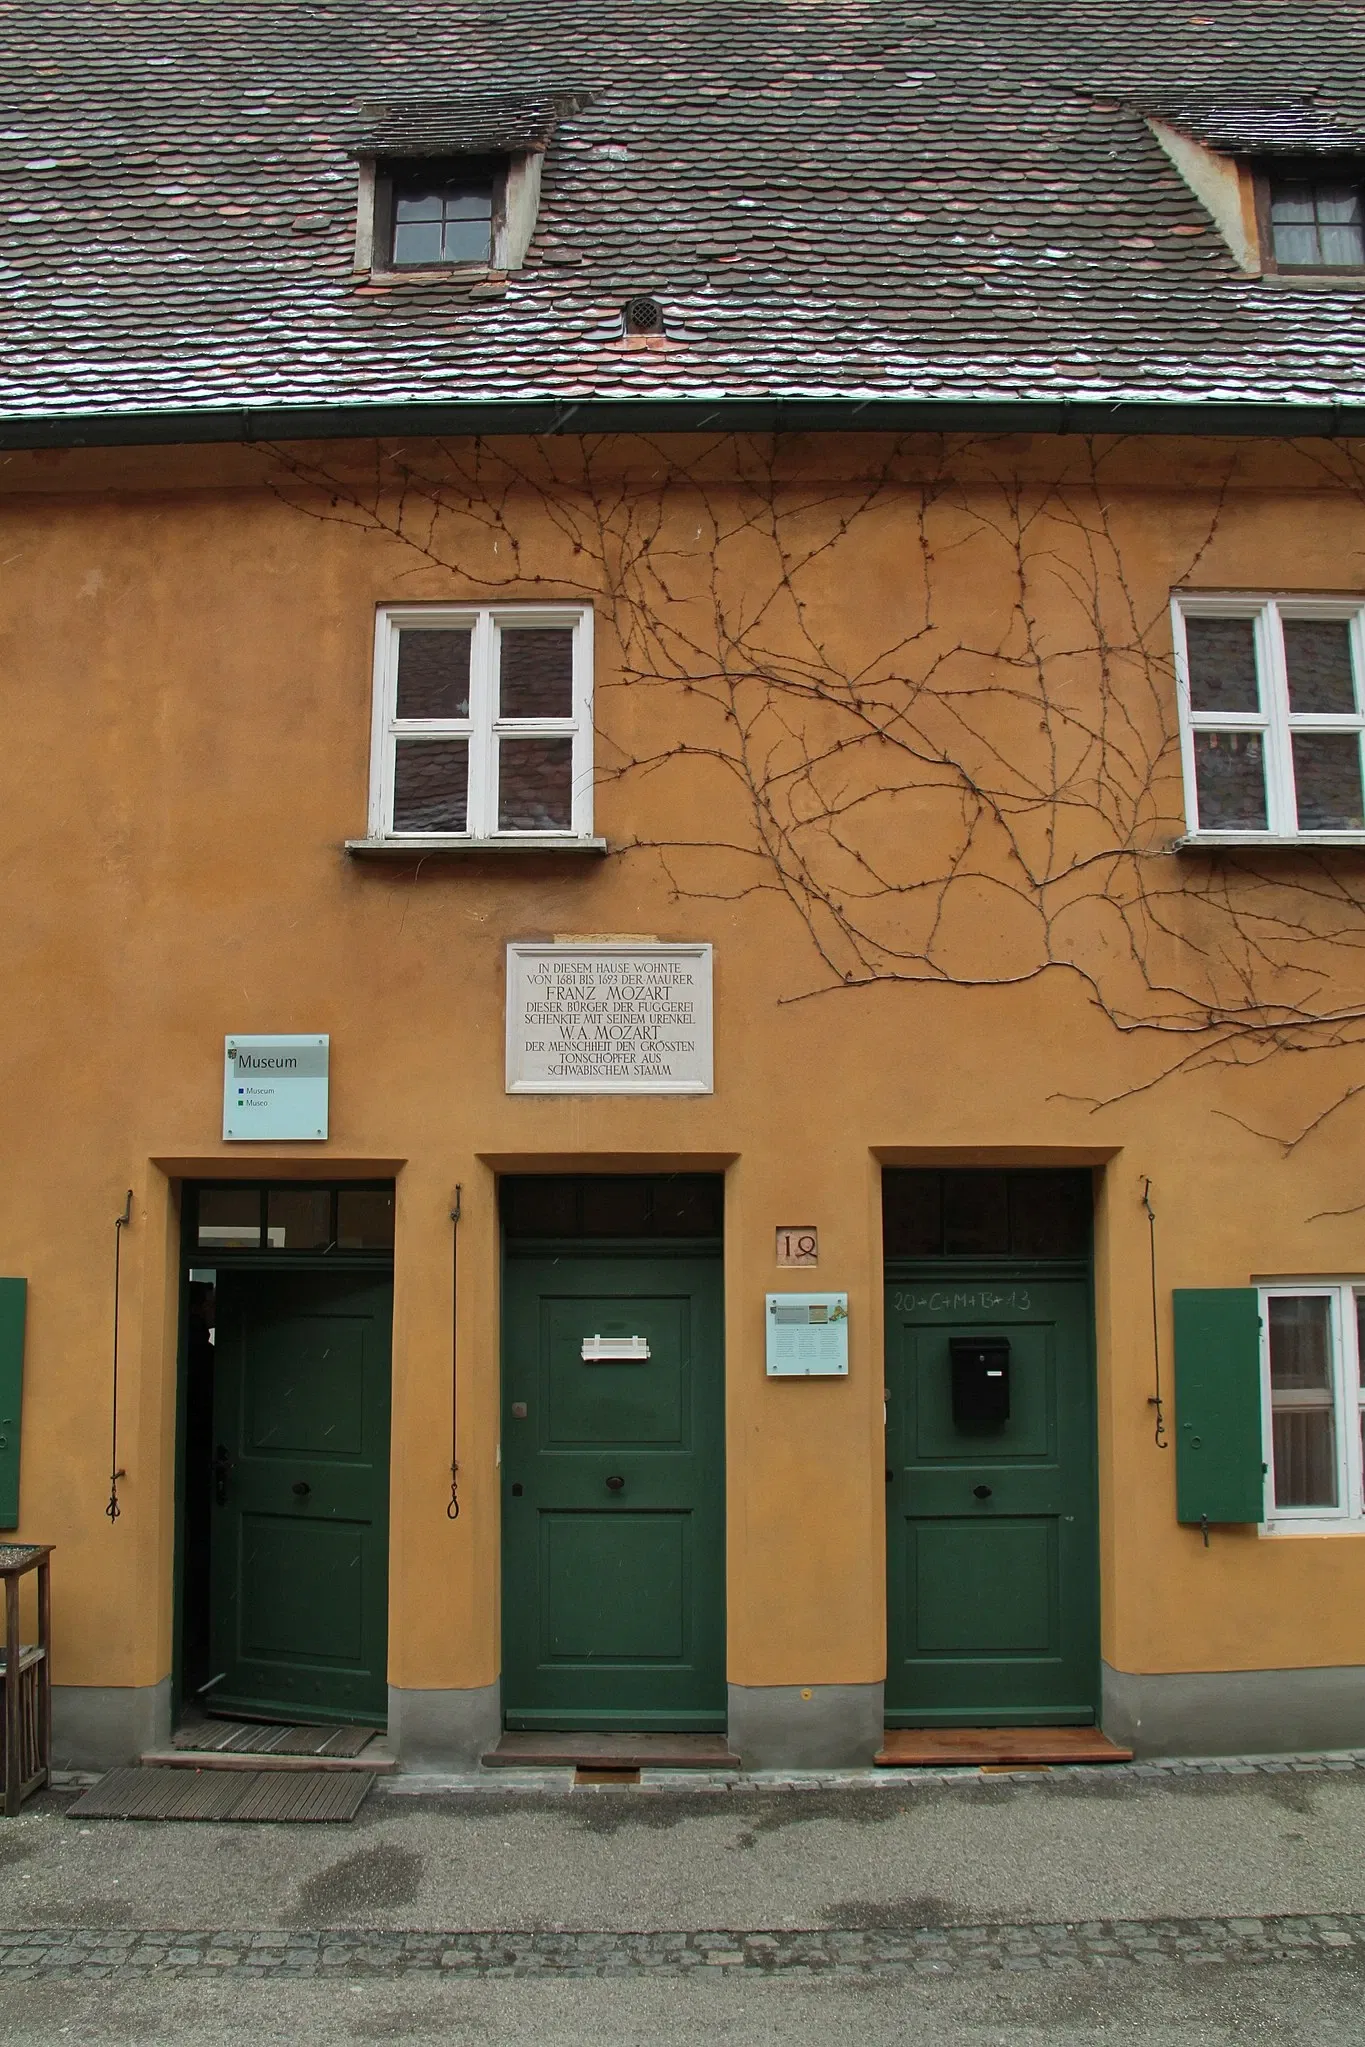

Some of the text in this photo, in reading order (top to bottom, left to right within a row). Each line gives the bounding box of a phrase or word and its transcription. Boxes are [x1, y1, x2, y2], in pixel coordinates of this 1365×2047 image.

[539, 962, 682, 974] IN DIESEM HAUSE WOHNTE
[527, 974, 694, 985] VON 1681 BIS 1693 DER MAURER
[547, 986, 673, 1000] FRANZ MOZART
[526, 1002, 563, 1012] DIESER
[613, 1002, 635, 1012] DER
[638, 1002, 694, 1012] FUGGEREI
[525, 1014, 696, 1024] SCHENKTE MIT SEINEM URENKEL
[560, 1026, 661, 1040] W. A. MOZART
[525, 1041, 545, 1052] DER
[548, 1041, 612, 1052] MENSCHHEIT
[616, 1041, 635, 1052] DEN
[238, 1055, 297, 1068] Museum
[641, 1052, 662, 1064] AUS
[634, 1064, 672, 1076] STAMM
